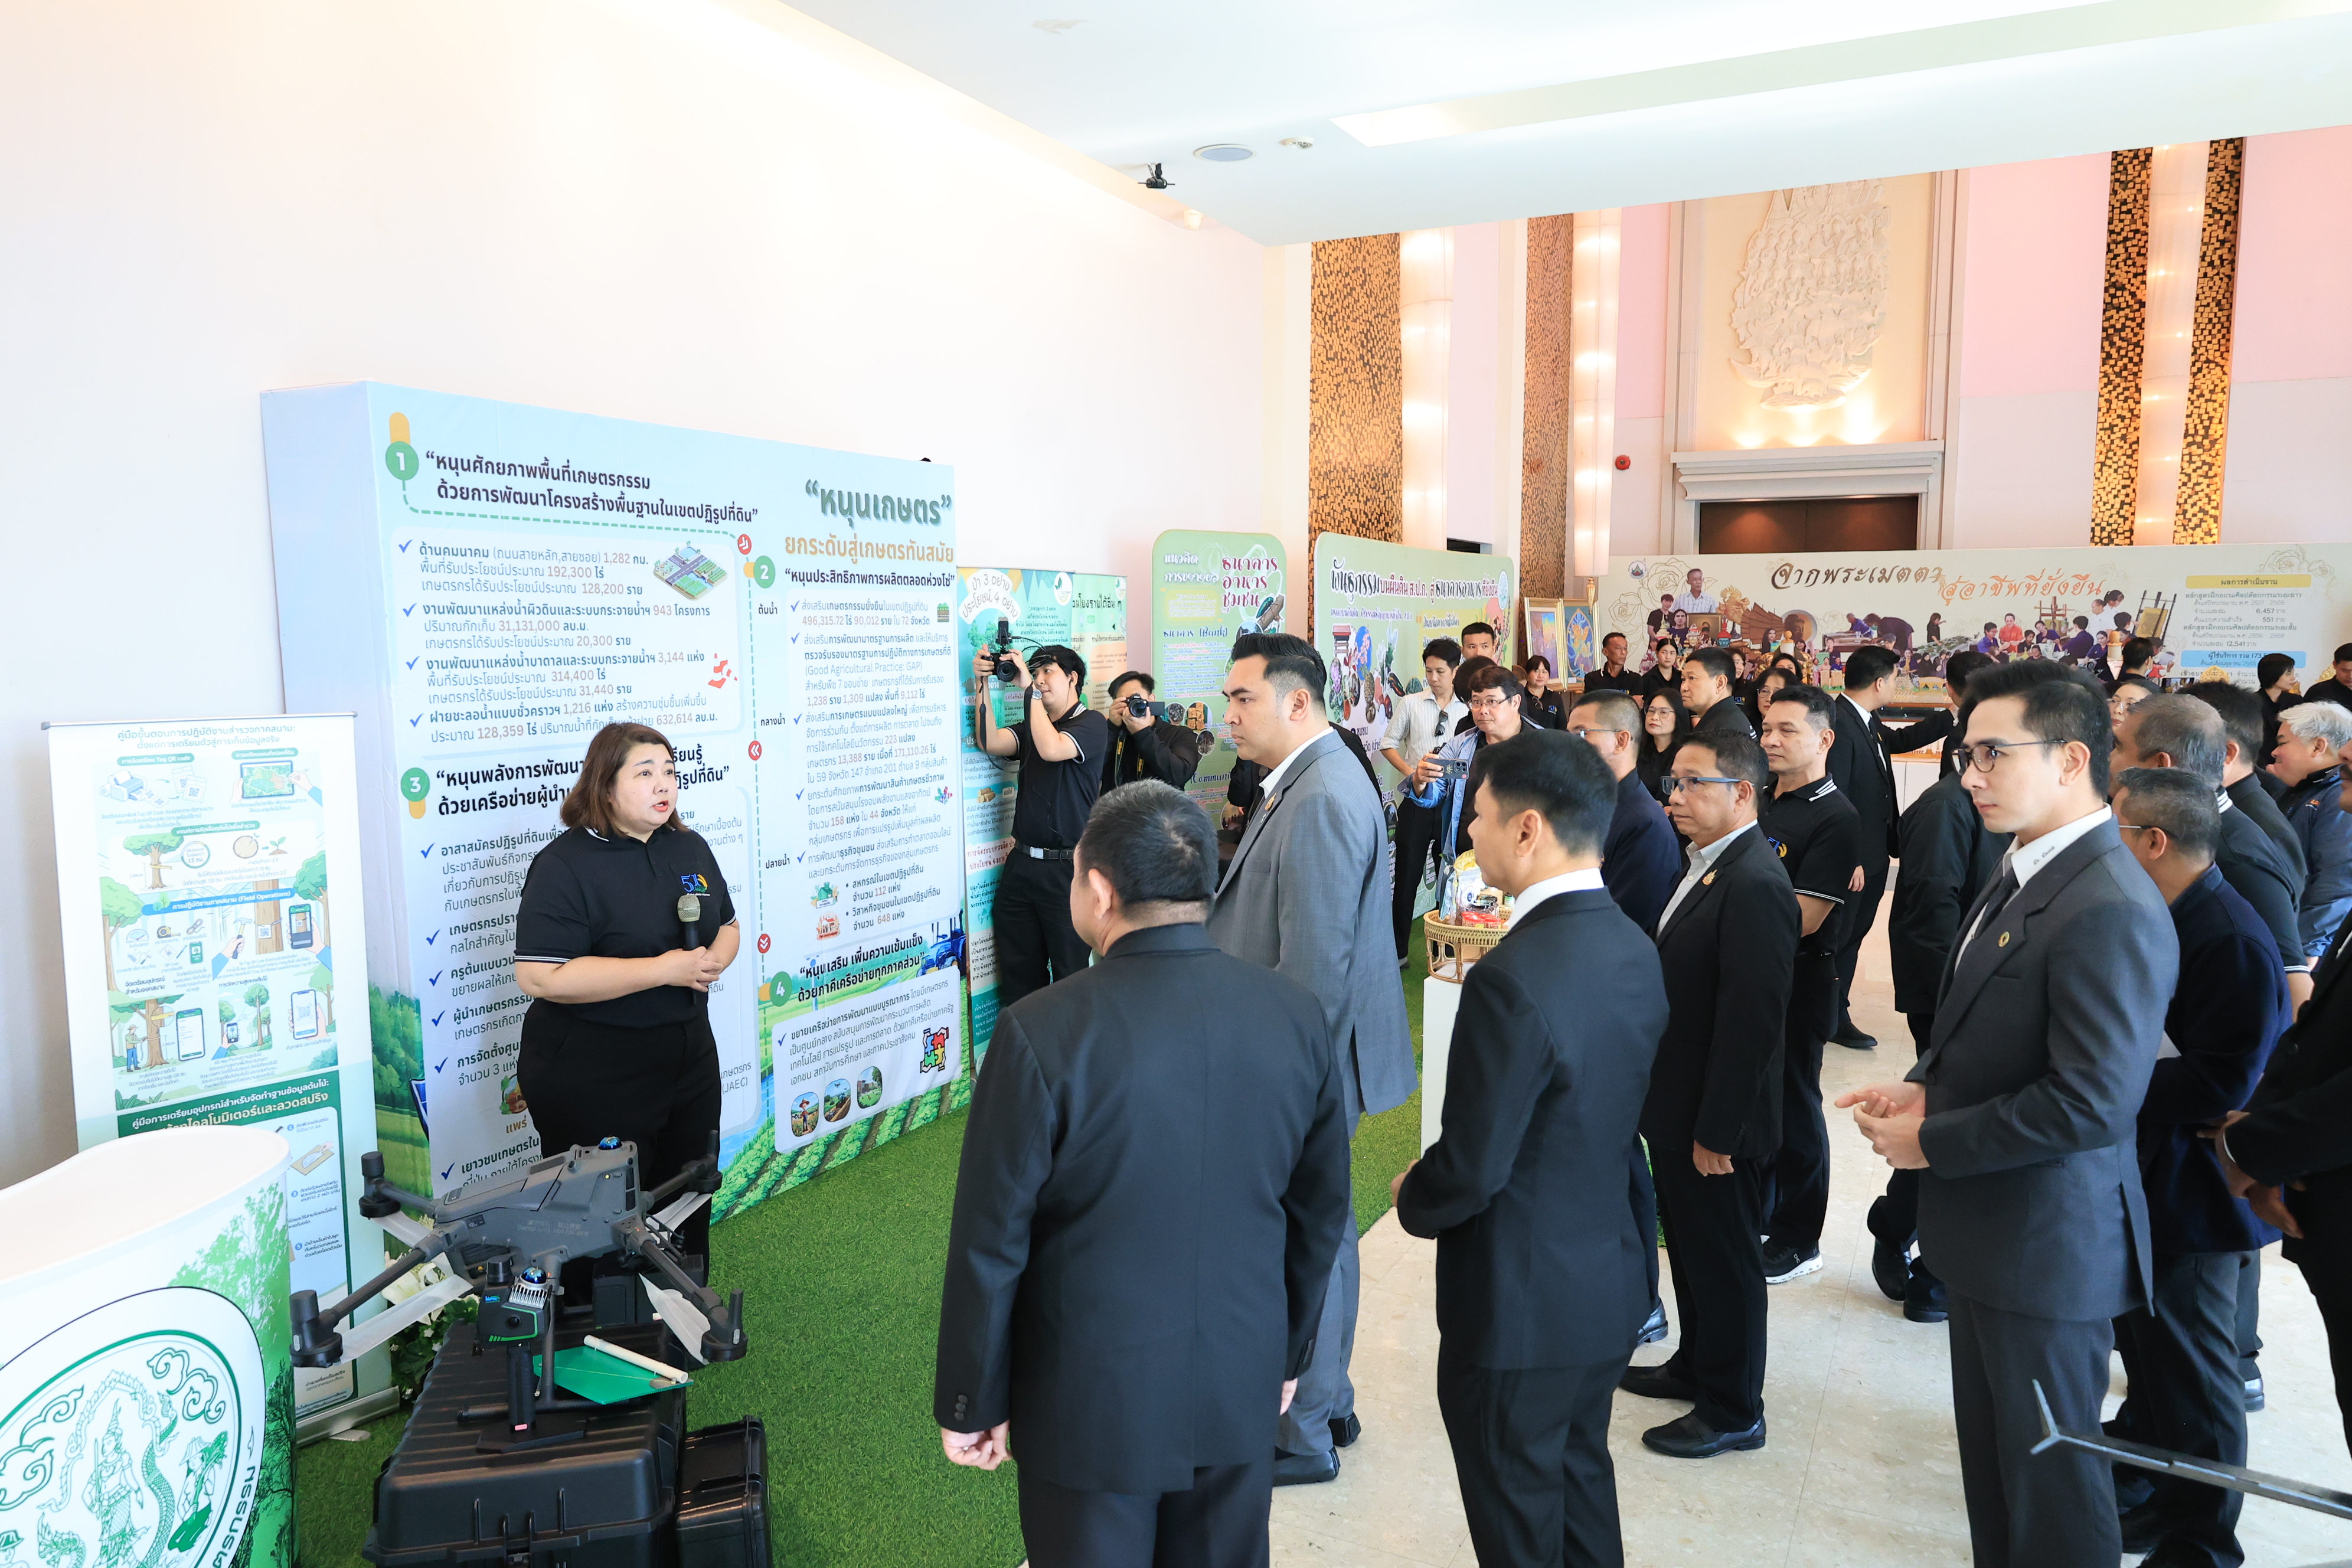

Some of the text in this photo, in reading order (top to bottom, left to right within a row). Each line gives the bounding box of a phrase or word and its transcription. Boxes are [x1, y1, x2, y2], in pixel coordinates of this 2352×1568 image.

[396, 451, 406, 471] 1
[426, 450, 650, 489] “หนุนศักยภาพพื้นที่เกษตรกรรม
[437, 478, 758, 525] ด้วยการพัฒนาโครงสร้างพื้นฐานในเขตปฏิรูปที่ดิน”
[805, 479, 952, 530] “หนุนเกษตร”
[419, 541, 631, 566] ด้านคมนาคม (ถนนสายหลัก,สายซอย) 1,282
[785, 533, 954, 564] ยกระดับสู่เกษตรทันสมัย
[1164, 551, 1198, 564] แนวคิด
[420, 556, 605, 579] พื้นที่รับประโยชน์ประมาณ 192,300 ไร่
[760, 564, 769, 580] 2
[1222, 557, 1278, 571] ธนาคาร
[785, 568, 955, 587] “หนุนประสิทธิภาพการผลิตตลอดห่วงโซ่”
[972, 573, 1010, 591] ป่า 3 อย่าง
[1164, 572, 1219, 583] การขยายผล
[1223, 576, 1268, 589] อาหาร
[1331, 558, 1409, 602] พันธุกรรมบนผืนดิน
[1409, 577, 1427, 596] ส.ป.ก.
[1436, 574, 1498, 599] ธนาคารอาหารที่ยั่งยืน
[1771, 563, 1942, 589] จากพระเมตตา
[422, 578, 642, 596] เกษตรกรได้รับประโยชน์ประมาณ 128,200 ราย
[1939, 568, 2106, 605] สู่อาชีพที่ยั่งยืน
[654, 603, 710, 616] 943 โครงการ
[758, 601, 778, 615] ต้นน้ำ
[962, 589, 1018, 618] ประโยชน์ 4 อย่าง
[1118, 599, 1122, 612] ๆ
[1221, 592, 1260, 613] ชุมชน
[424, 618, 560, 633] ปริมาณกักเก็บ 31,131,000
[854, 616, 879, 627] 90,012
[881, 617, 892, 625] ราย
[893, 616, 900, 625] ใน
[901, 616, 909, 625] 72
[910, 615, 930, 625] จังหวัด
[1200, 625, 1228, 638] (Bank)
[425, 635, 631, 649] เกษตรกรได้รับประโยชน์ประมาณ 20,300 ราย
[658, 649, 704, 665] 3,144 แห่ง
[427, 668, 606, 687] พื้นที่รับประโยชน์ประมาณ 314,400 ไร่
[805, 661, 923, 677] (Good Agricultural Practice: GAP)
[838, 678, 868, 689] 7 ขอบข่าย
[429, 684, 632, 704] เกษตรกรได้รับประโยชน์ประมาณ 31,440 ราย
[807, 689, 918, 708] 1,238 ราย 1,309 แปลง 9,112
[430, 692, 707, 723] ฝายชะลอน้ำแบบชั่วคราวฯ 1,216 แห่ง สร้างความชุ่มชื้นเพิ่มขึ้น
[805, 705, 907, 723] ส่งเสริมการเกษตรแบบแปลงใหญ่
[432, 713, 692, 743] ประมาณ 128,359 ไร่ 632,614
[760, 713, 785, 726] กลางน้ำ
[885, 734, 916, 744] 223 แปลง
[807, 753, 876, 768] เกษตรกร 13,388 ราย
[807, 763, 897, 783] ใน 59 147 201
[409, 776, 422, 793] 3
[808, 809, 879, 831] จำนวน 158 แห่ง 44
[808, 827, 951, 864] การพัฒนาธุรกิจชุมชน ส่งเสริมการทำตลาดออนไลน์
[681, 874, 701, 892] 51
[852, 863, 924, 888] สหกรณ์ในเขตปฏิรูปที่ดิน
[238, 893, 256, 903] (Field
[256, 890, 291, 901] Operations)
[852, 881, 901, 902] จำนวน 112 แห่ง
[852, 886, 940, 917] วิสาหกิจชุมชนในเขตปฏิรูปที่ดิน
[853, 910, 905, 931] จำนวน 648 แห่ง
[851, 933, 923, 965] เพิ่มความเข้มแข็ง
[798, 952, 925, 1002] ด้วยภาคีเครือข่ายทุกภาคส่วน”
[776, 981, 786, 997] 4
[855, 1027, 892, 1047] และการตลาด
[893, 1004, 954, 1033] ด้วยภาคีเครือข่ายภาครัฐ
[458, 1063, 500, 1086] จำนวน 3
[790, 1070, 811, 1086] เอกชน
[721, 1077, 748, 1096] (JAEC)
[132, 1079, 329, 1130] คู่มือการเตรียมอุปกรณ์สำหรับจัดทำฐานข้อมูลต้นไม้:
